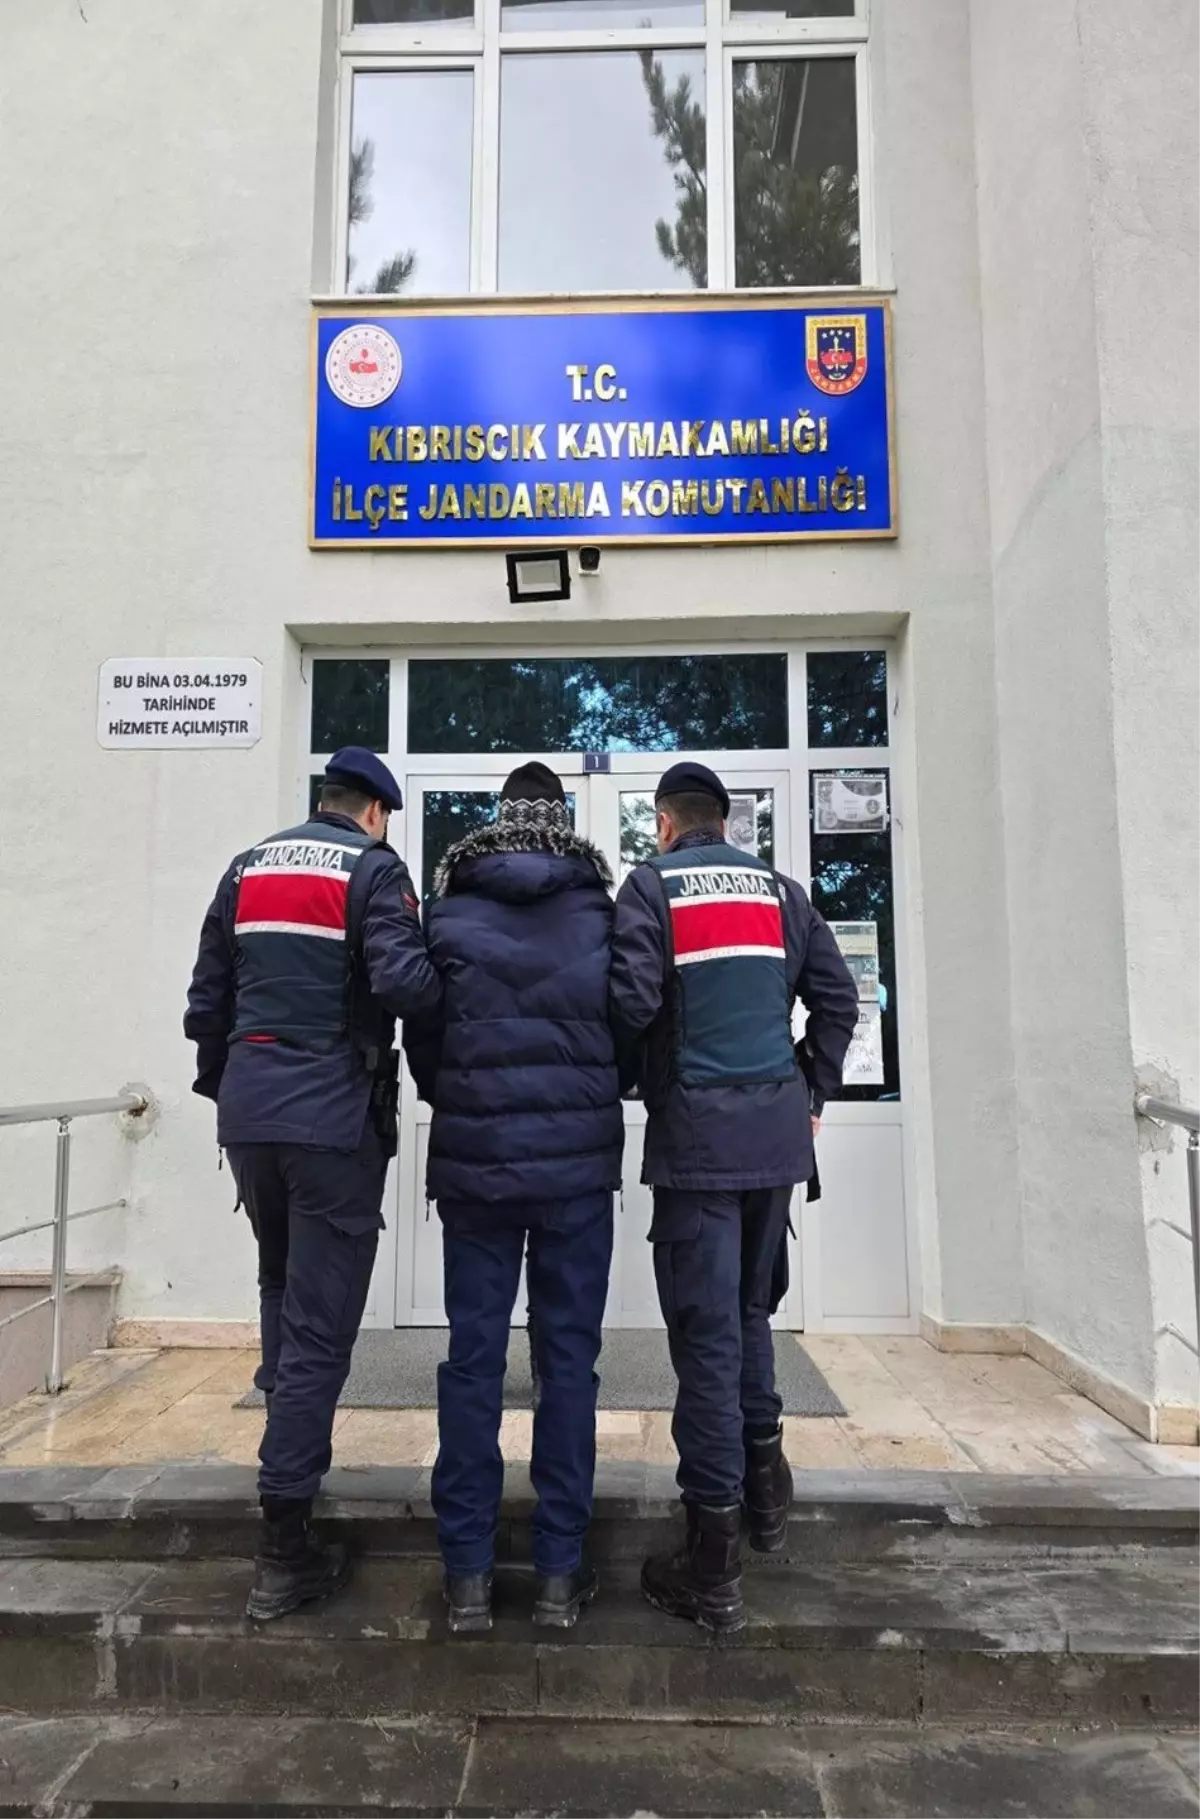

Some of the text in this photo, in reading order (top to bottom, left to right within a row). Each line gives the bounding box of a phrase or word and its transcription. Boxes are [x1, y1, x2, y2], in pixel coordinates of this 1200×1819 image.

[566, 364, 627, 401] T.C.
[557, 408, 828, 459] KAYMAKAMLIĞI
[332, 466, 866, 531] İLÇE JANDARMA KOMUTANLIĞI
[113, 672, 248, 689] BU BİNA 03.04.1979
[143, 695, 216, 711] TARİHİNDE
[109, 719, 248, 737] HİZMETE AÇILMIŞTIR
[594, 755, 600, 768] 1
[254, 845, 343, 870] JANDARMA
[679, 873, 771, 896] JANDARMA
